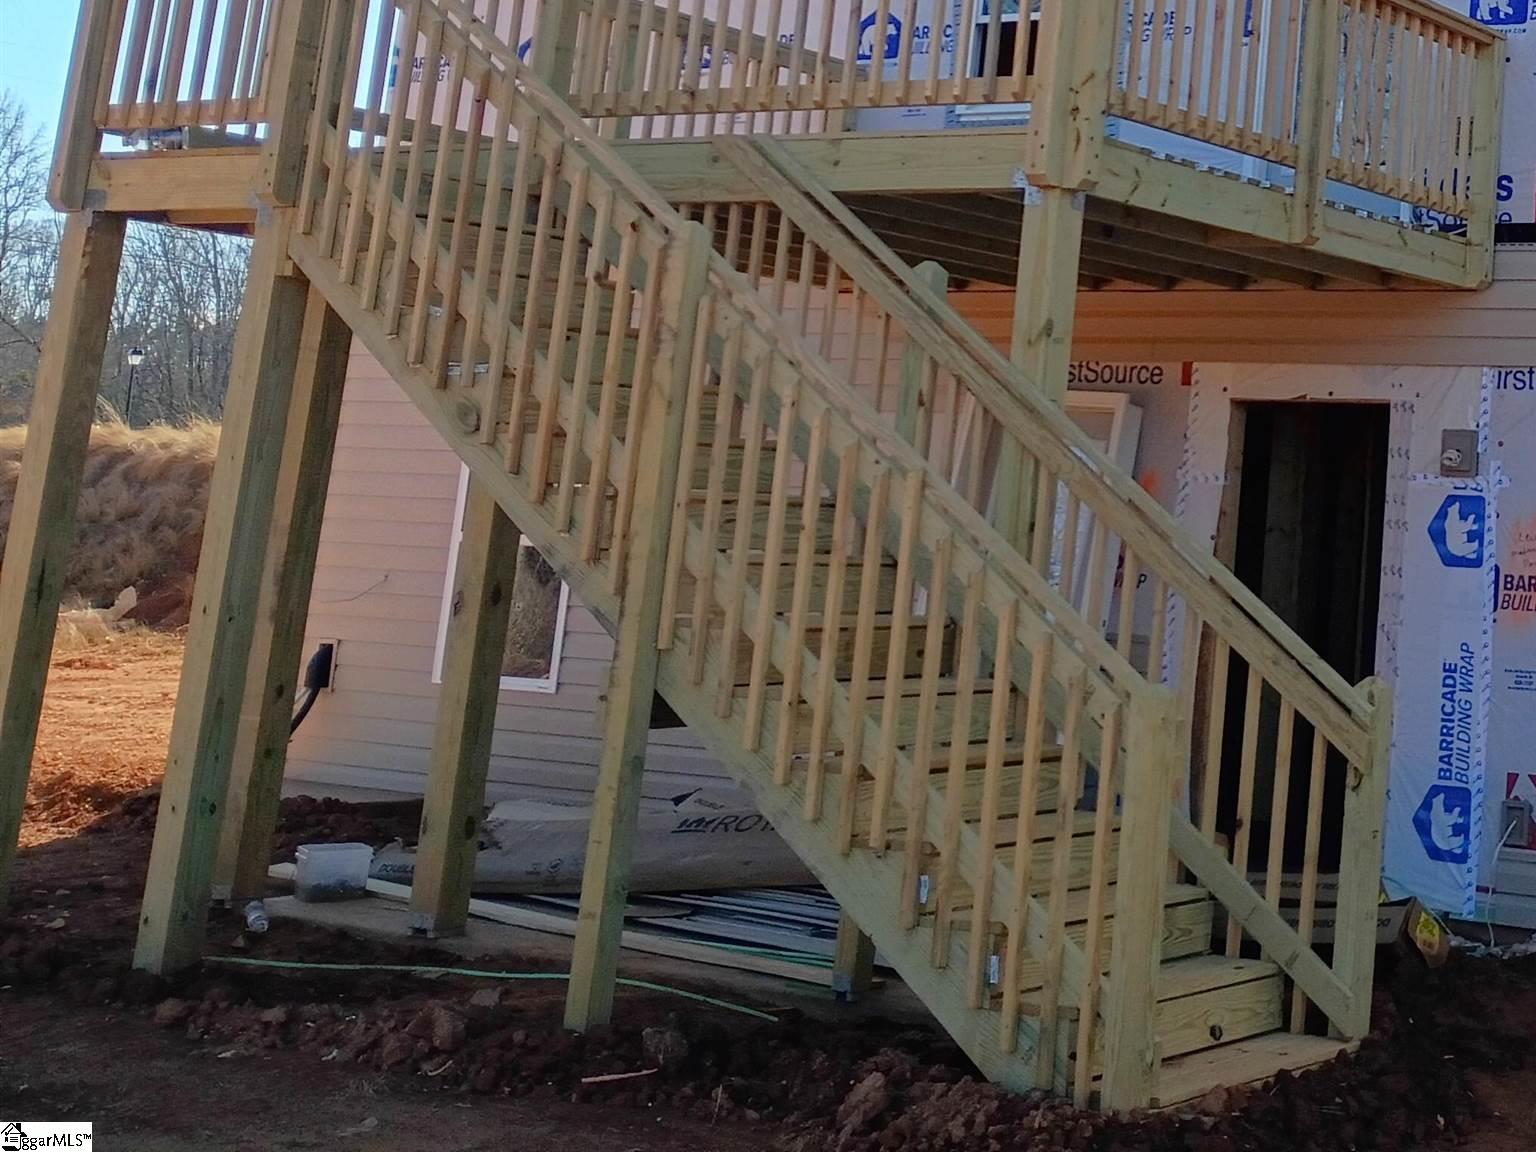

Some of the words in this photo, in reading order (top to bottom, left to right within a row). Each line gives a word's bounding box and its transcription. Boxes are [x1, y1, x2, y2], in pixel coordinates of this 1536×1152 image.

[1458, 642, 1475, 693] WRAP
[1437, 662, 1459, 781] BARRICADE
[1454, 698, 1473, 785] BUILDING
